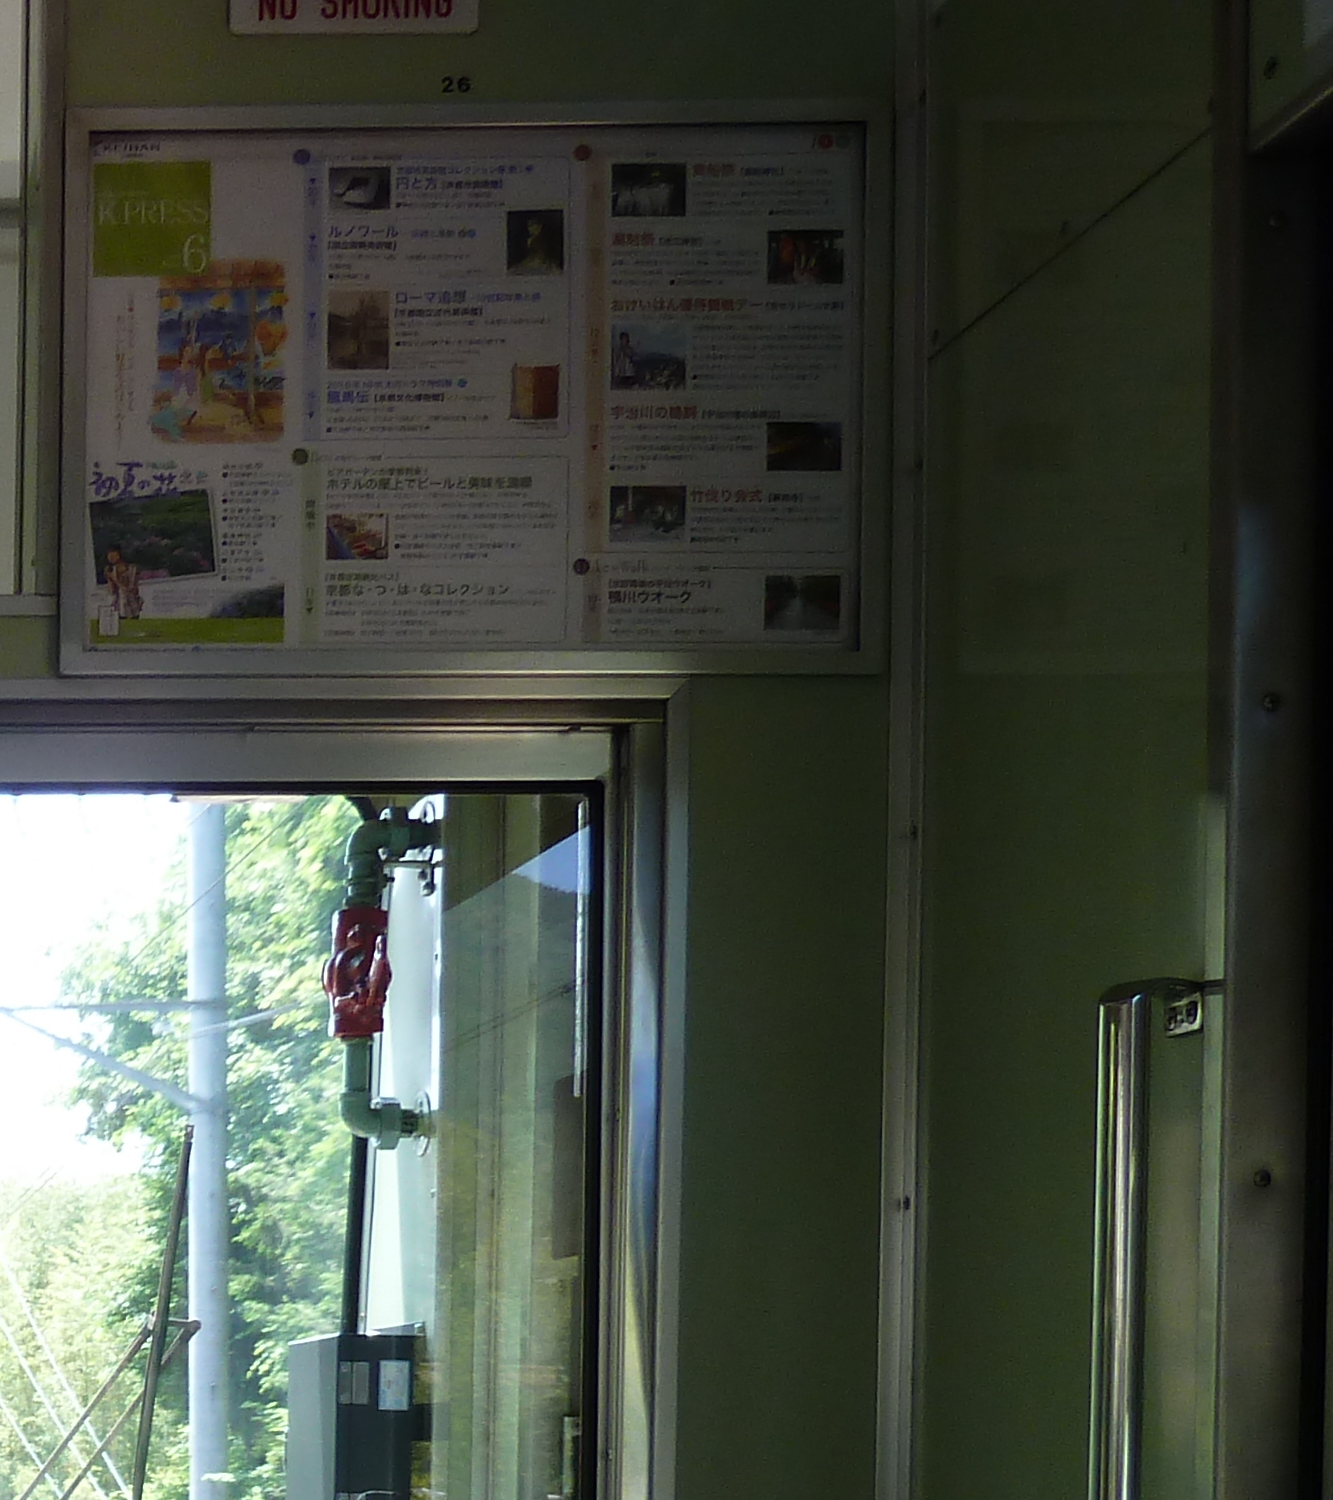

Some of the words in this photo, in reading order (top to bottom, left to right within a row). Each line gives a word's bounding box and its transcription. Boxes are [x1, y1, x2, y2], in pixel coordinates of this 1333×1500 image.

[258, 0, 297, 20] NO
[321, 0, 453, 19] SMOKING
[441, 77, 470, 93] 26
[124, 199, 208, 225] PRESS
[327, 225, 399, 239] ルノワール
[183, 234, 207, 273] 6
